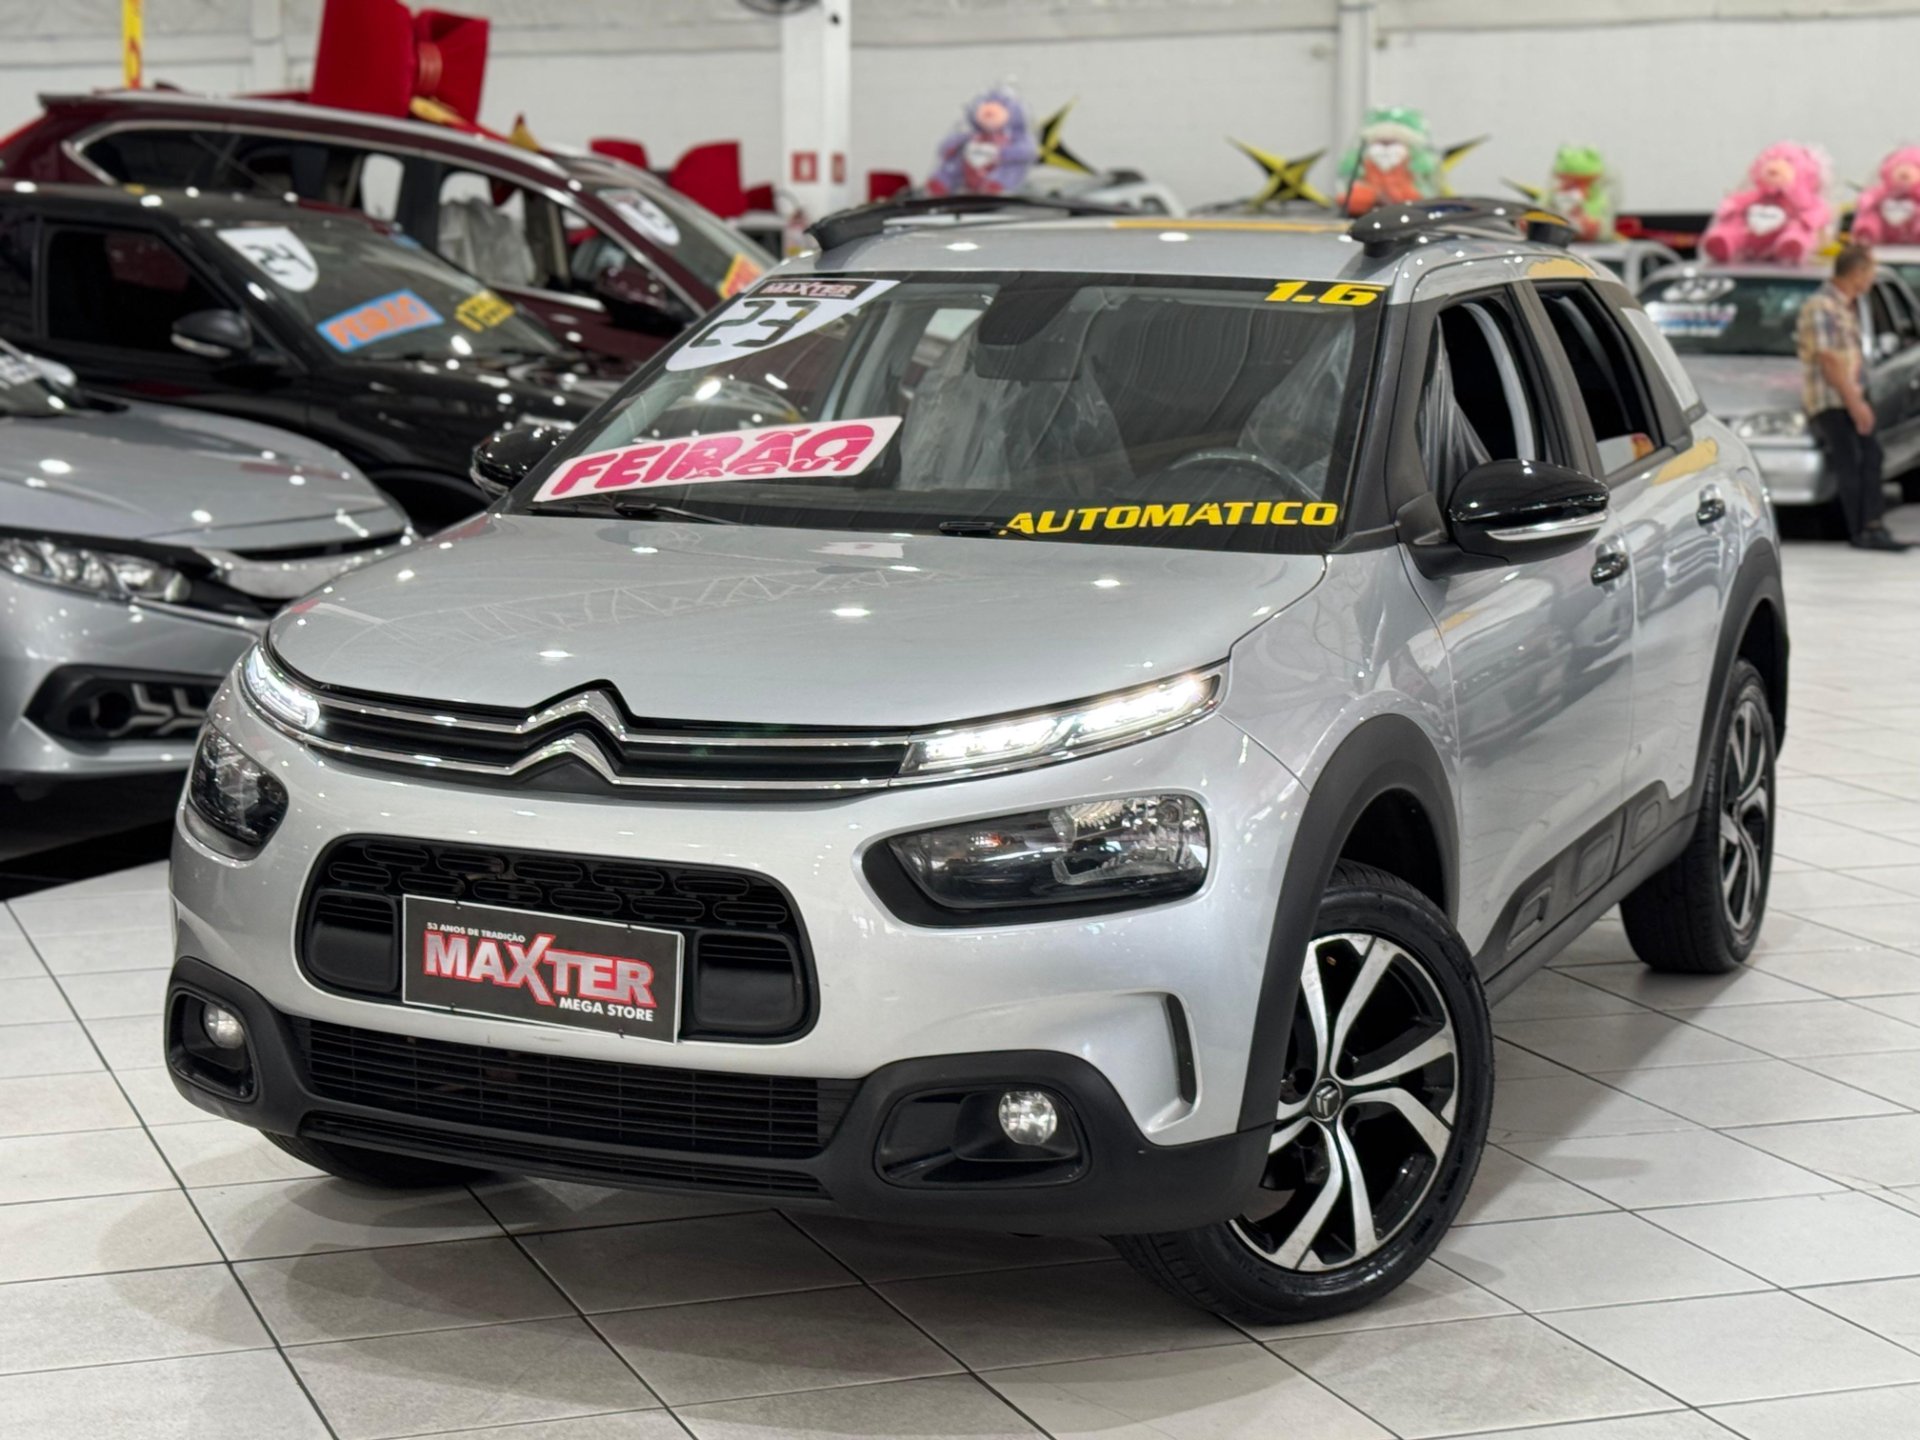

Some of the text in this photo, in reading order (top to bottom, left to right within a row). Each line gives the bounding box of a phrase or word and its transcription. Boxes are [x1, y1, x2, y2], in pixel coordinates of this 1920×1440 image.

[760, 281, 857, 297] MAXTER
[1264, 281, 1387, 306] 1.6
[688, 300, 821, 348] 23
[551, 424, 874, 496] FEIRÃO
[440, 924, 466, 934] ANOS
[467, 928, 479, 936] DE
[423, 931, 657, 1007] MAXTER
[559, 997, 654, 1022] MEGA STORE
